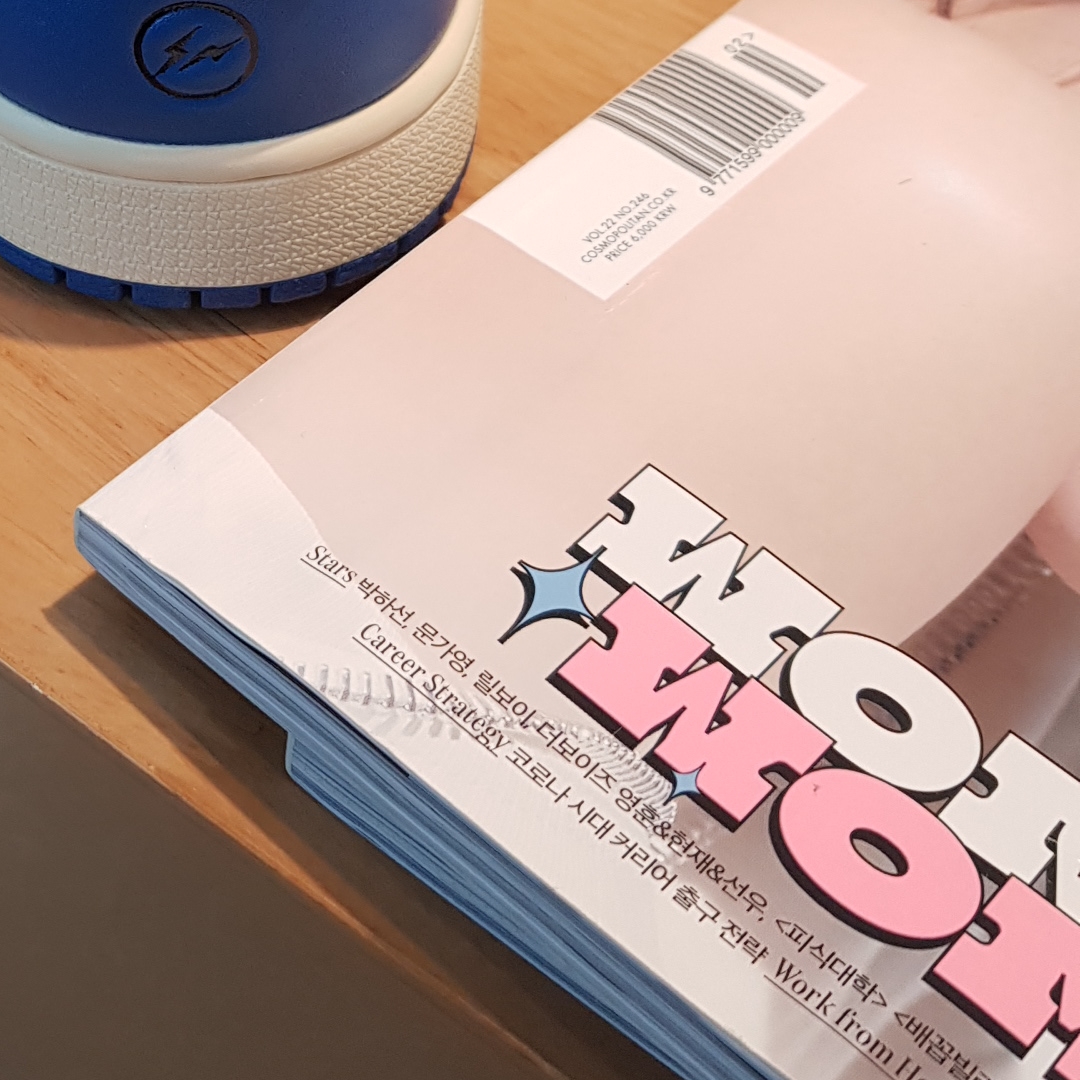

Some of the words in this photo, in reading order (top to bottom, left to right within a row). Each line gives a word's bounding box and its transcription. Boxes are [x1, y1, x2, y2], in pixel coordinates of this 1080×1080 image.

[604, 239, 634, 262] PRICE
[653, 203, 678, 222] KRW
[305, 544, 359, 584] Stars
[357, 577, 416, 630] 박하선,
[412, 622, 476, 678] 문가영,
[536, 721, 618, 794] 더보이즈
[359, 622, 427, 680] Career
[422, 672, 512, 751] Strategy
[505, 746, 572, 804] 코로나
[567, 799, 616, 840] 시대
[609, 831, 678, 892] 커리어
[672, 884, 724, 924] 출구
[719, 919, 770, 965] 전략
[773, 956, 836, 1017] Work
[834, 1007, 896, 1067] from
